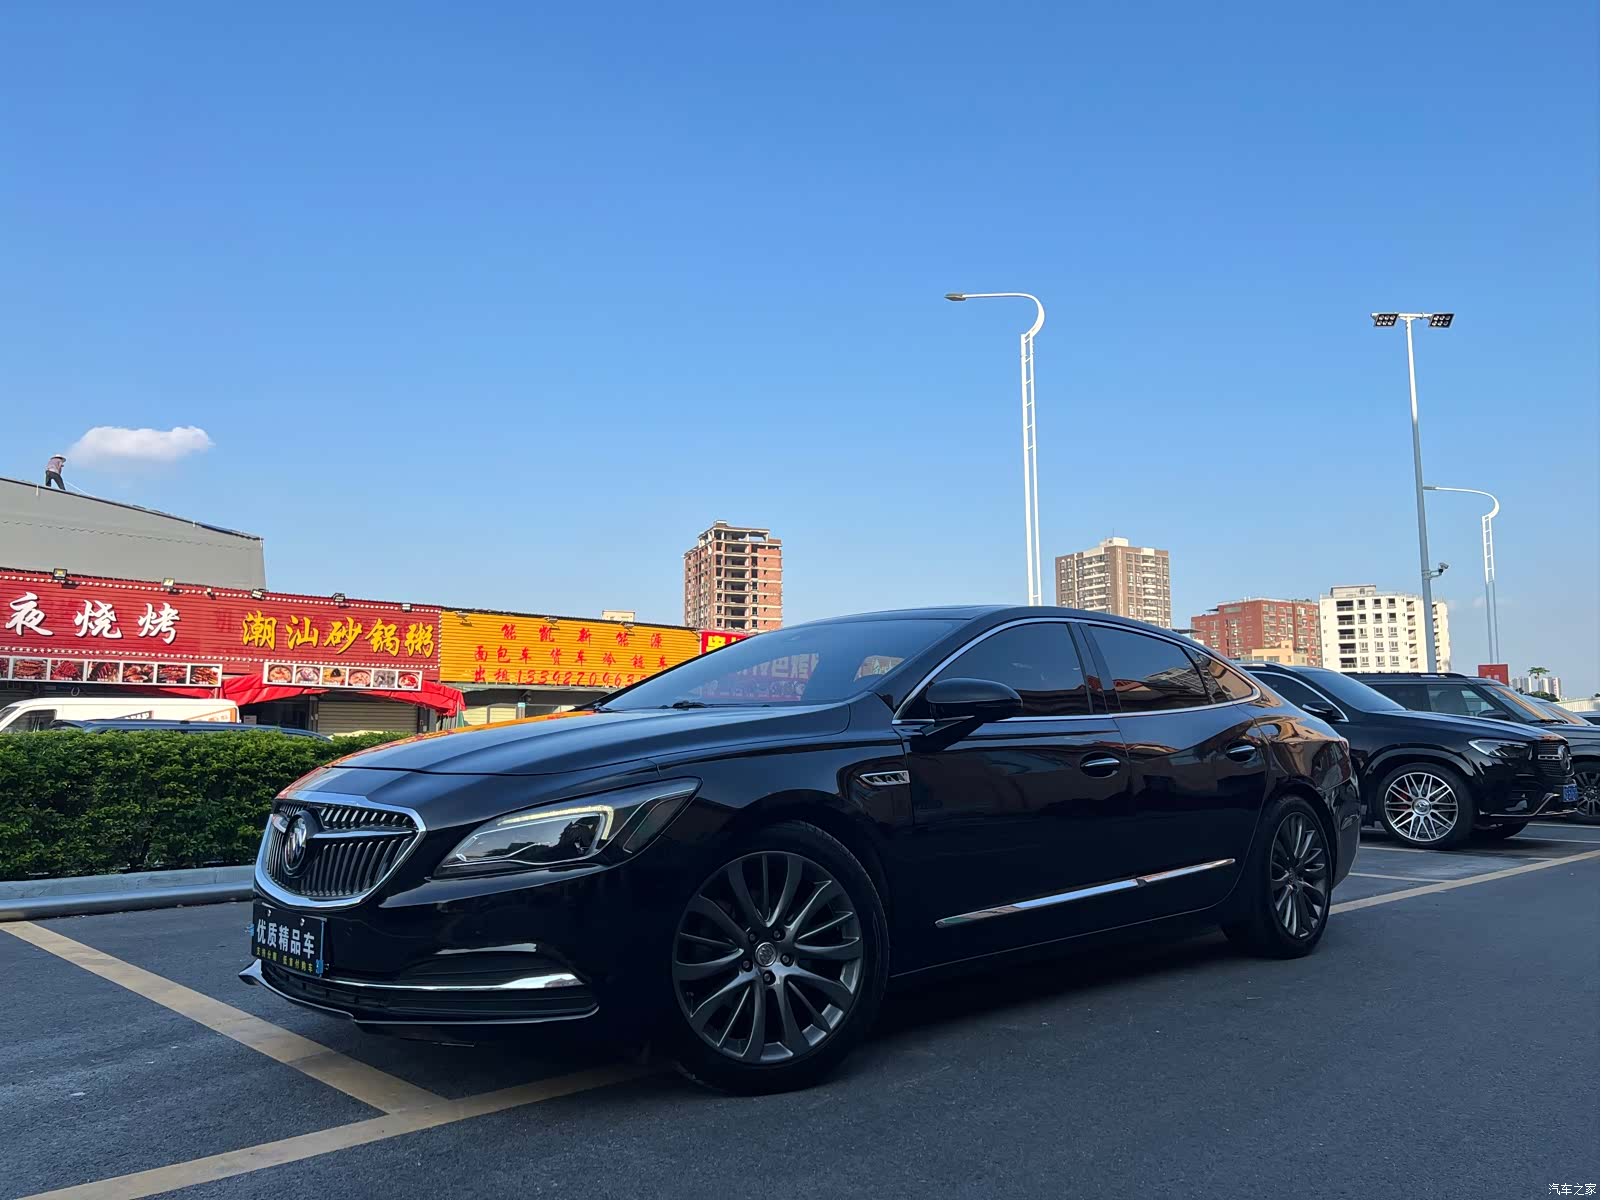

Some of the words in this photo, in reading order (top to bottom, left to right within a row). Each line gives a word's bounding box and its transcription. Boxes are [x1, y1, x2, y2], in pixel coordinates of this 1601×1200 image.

[5, 592, 180, 645] 夜烧烤
[242, 610, 435, 658] 潮汕砂锅粥
[256, 919, 315, 959] 优质精品车
